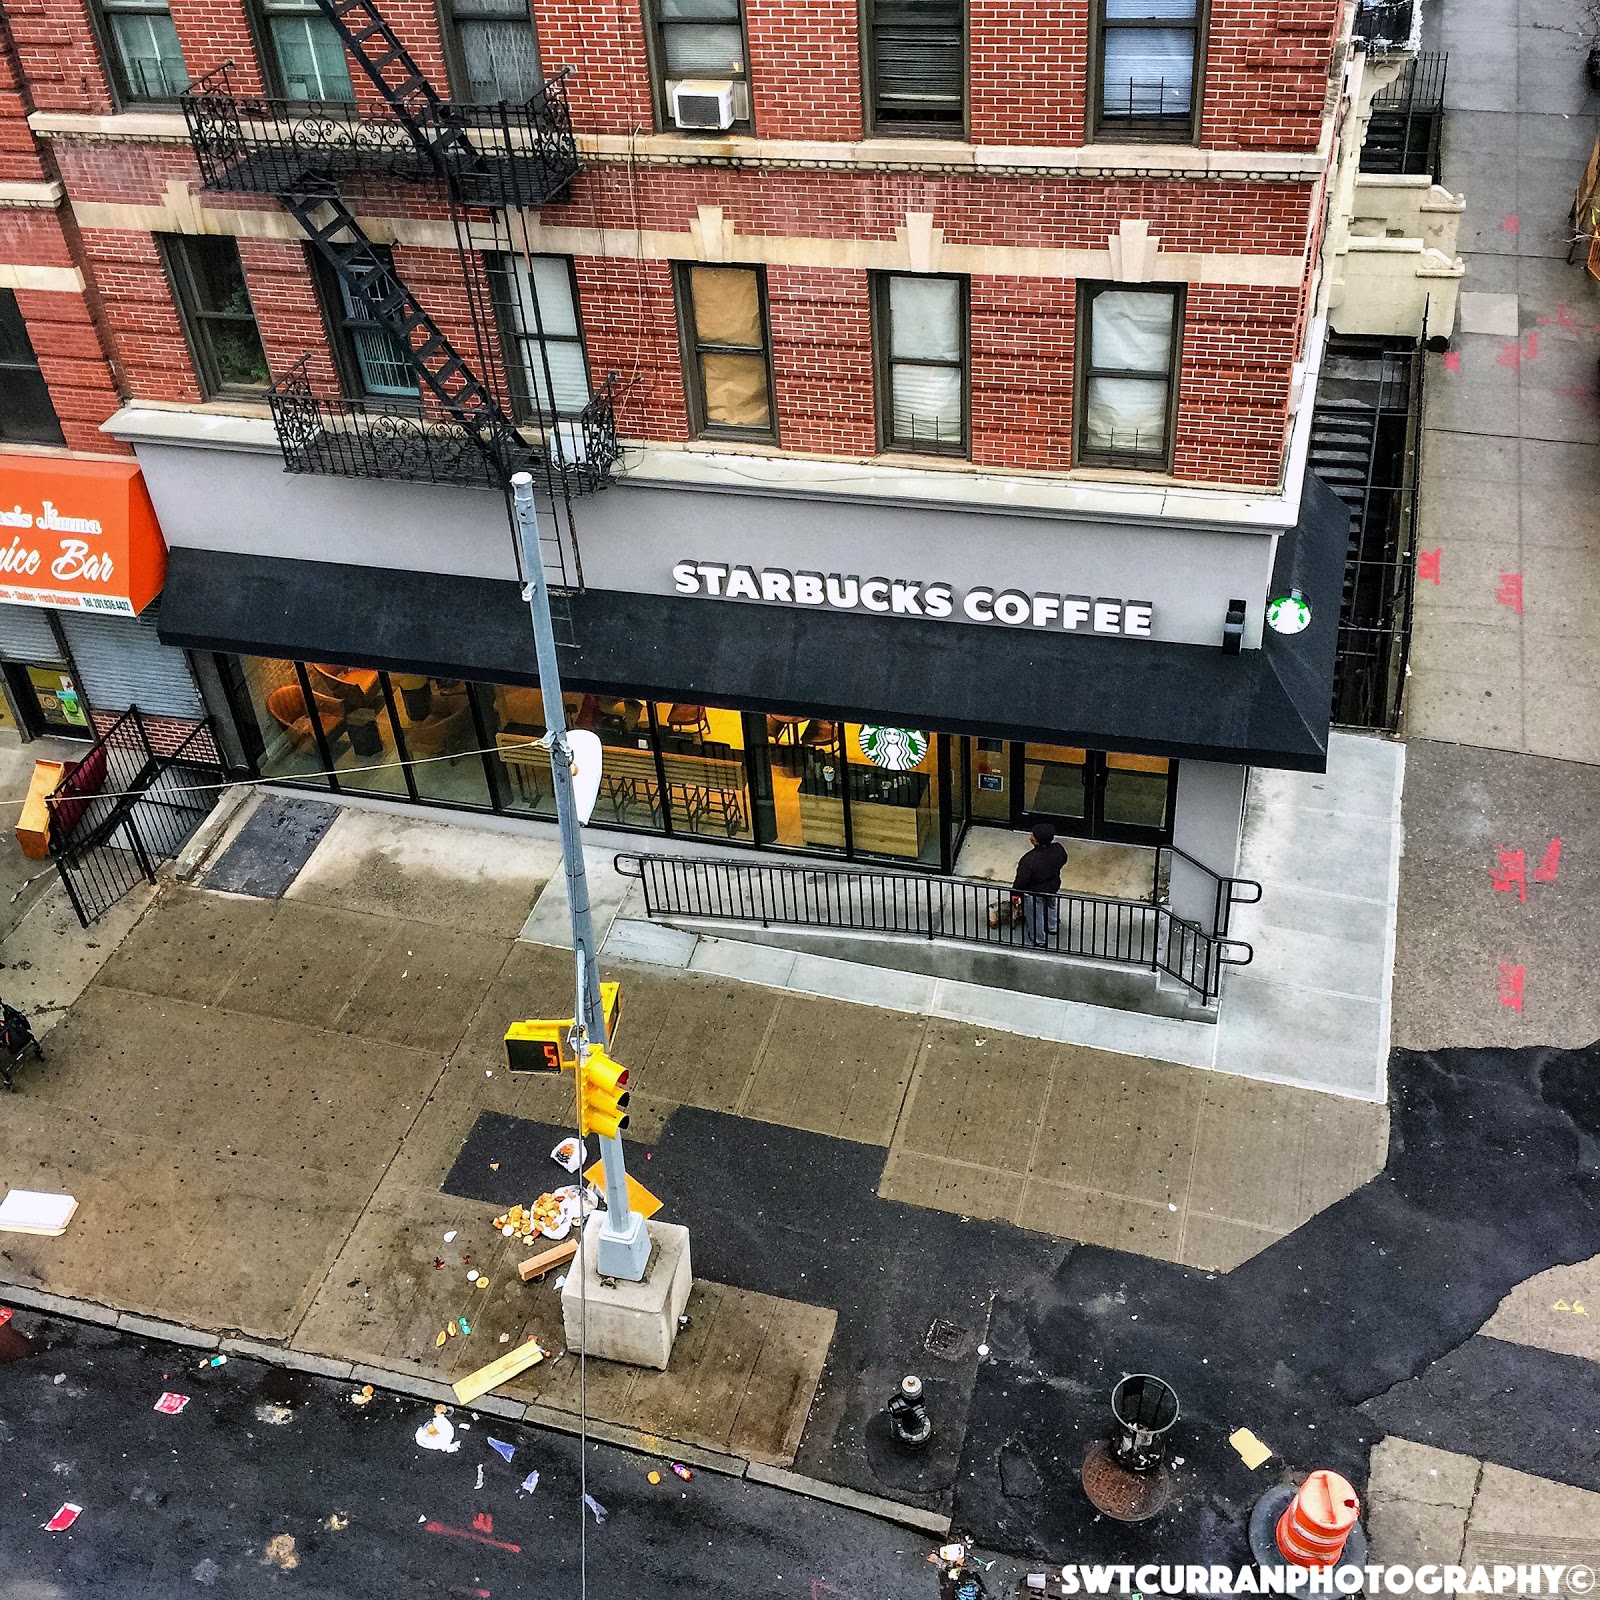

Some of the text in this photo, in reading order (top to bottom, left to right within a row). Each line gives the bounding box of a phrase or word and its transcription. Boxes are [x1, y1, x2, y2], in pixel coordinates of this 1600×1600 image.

[51, 539, 114, 582] Bar
[672, 559, 1153, 636] STARBUCKS COFFEE
[543, 1045, 558, 1067] 5
